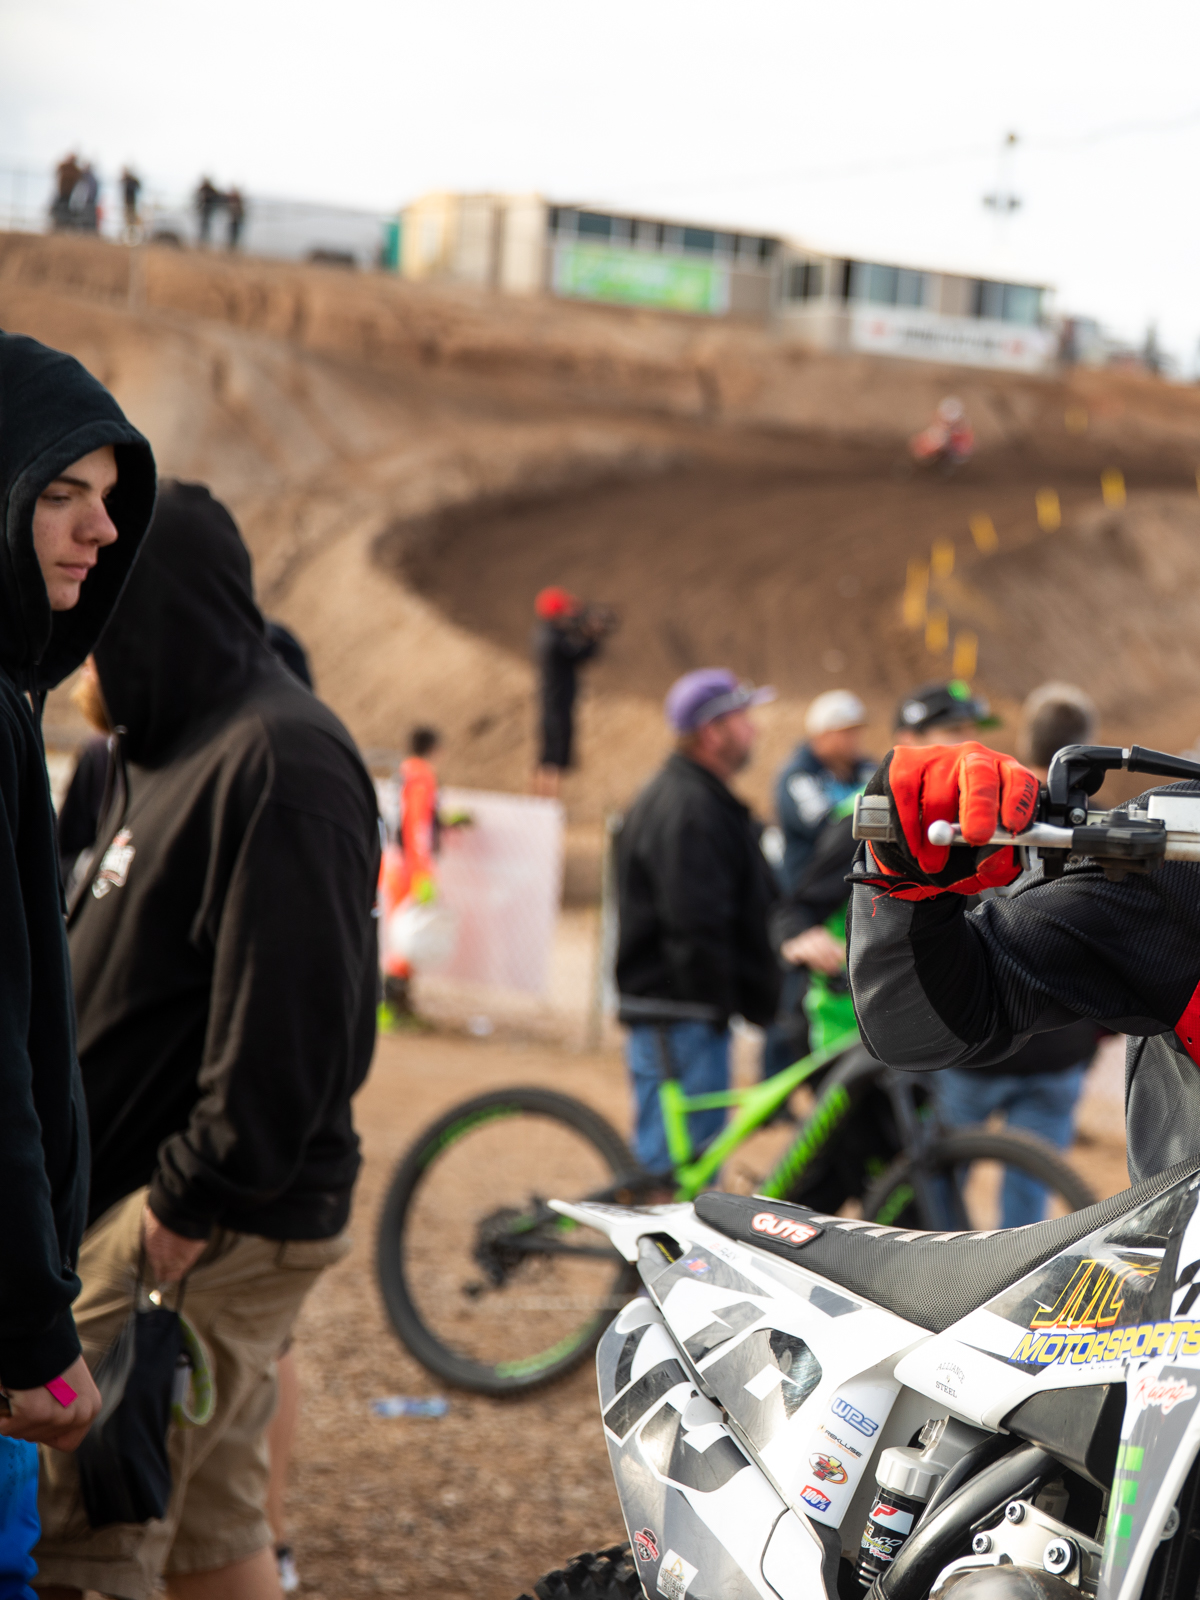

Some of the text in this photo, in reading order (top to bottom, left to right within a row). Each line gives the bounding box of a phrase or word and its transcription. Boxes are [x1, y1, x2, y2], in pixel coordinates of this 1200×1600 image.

[752, 1212, 817, 1244] GUTS
[1030, 1259, 1160, 1329] JMC
[936, 1362, 965, 1385] ALLIANCE
[935, 1380, 958, 1398] STEEL
[1133, 1376, 1192, 1409] Racing
[831, 1397, 879, 1437] WPS
[824, 1429, 864, 1458] REKLUSE
[802, 1486, 829, 1510] 100%
